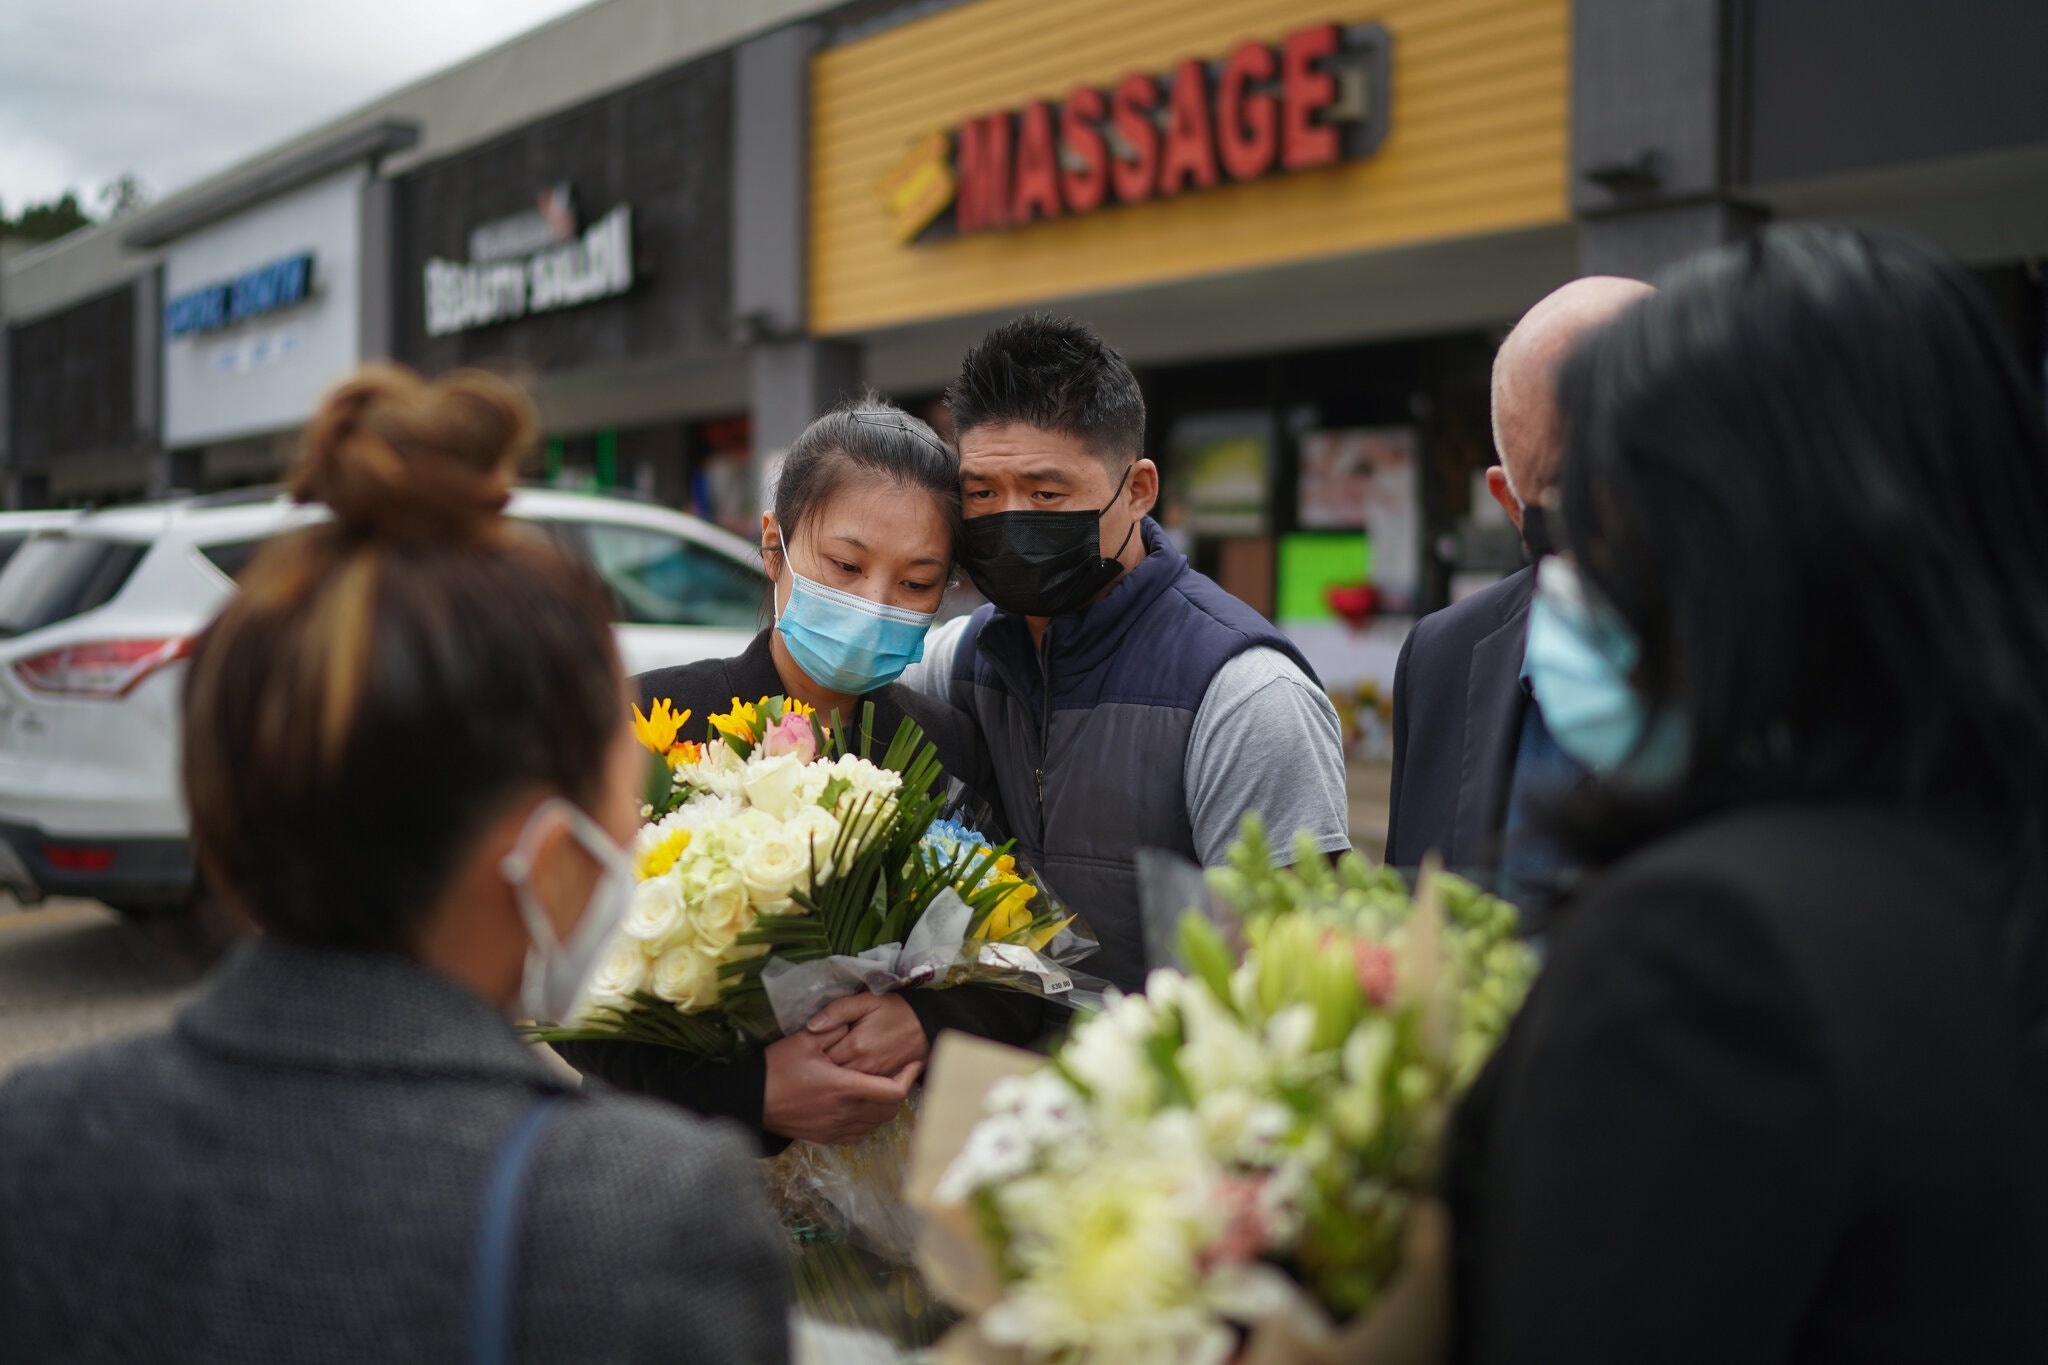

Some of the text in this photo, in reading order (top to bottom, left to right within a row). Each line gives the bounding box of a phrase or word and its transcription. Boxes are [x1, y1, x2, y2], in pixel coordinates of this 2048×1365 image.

[957, 23, 1339, 233] MASSAGE
[424, 256, 526, 336] BEAUTY
[528, 203, 633, 314] SALON
